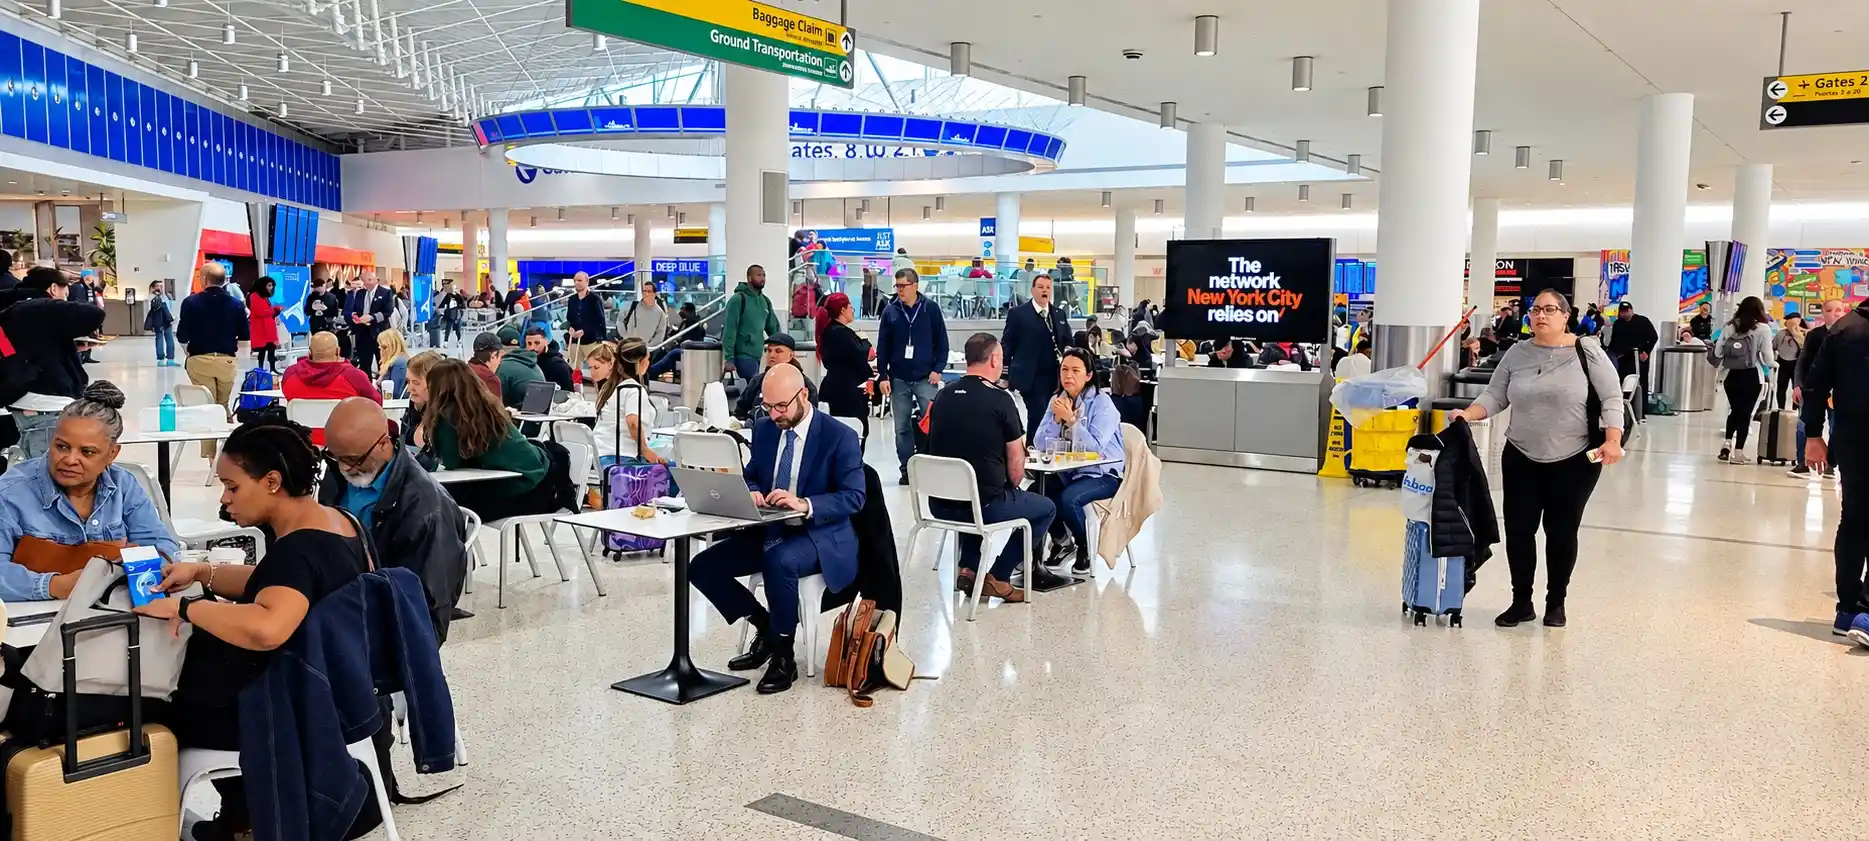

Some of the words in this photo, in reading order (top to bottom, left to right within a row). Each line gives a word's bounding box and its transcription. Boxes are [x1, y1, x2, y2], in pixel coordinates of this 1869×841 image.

[752, 7, 795, 32] Baggage
[797, 20, 823, 37] Claim
[710, 29, 750, 51] Ground
[752, 38, 823, 67] Transportation
[1815, 78, 1854, 88] Gates
[1860, 76, 1868, 85] 2
[790, 142, 833, 158] ates
[656, 262, 677, 272] DEEP
[679, 262, 701, 272] BLUE
[1228, 257, 1262, 273] The
[1495, 260, 1515, 270] ON
[1209, 272, 1281, 289] network
[1187, 288, 1225, 305] New
[1226, 288, 1267, 306] York
[1267, 289, 1303, 309] City
[1208, 305, 1253, 323] relies
[1256, 309, 1279, 323] on
